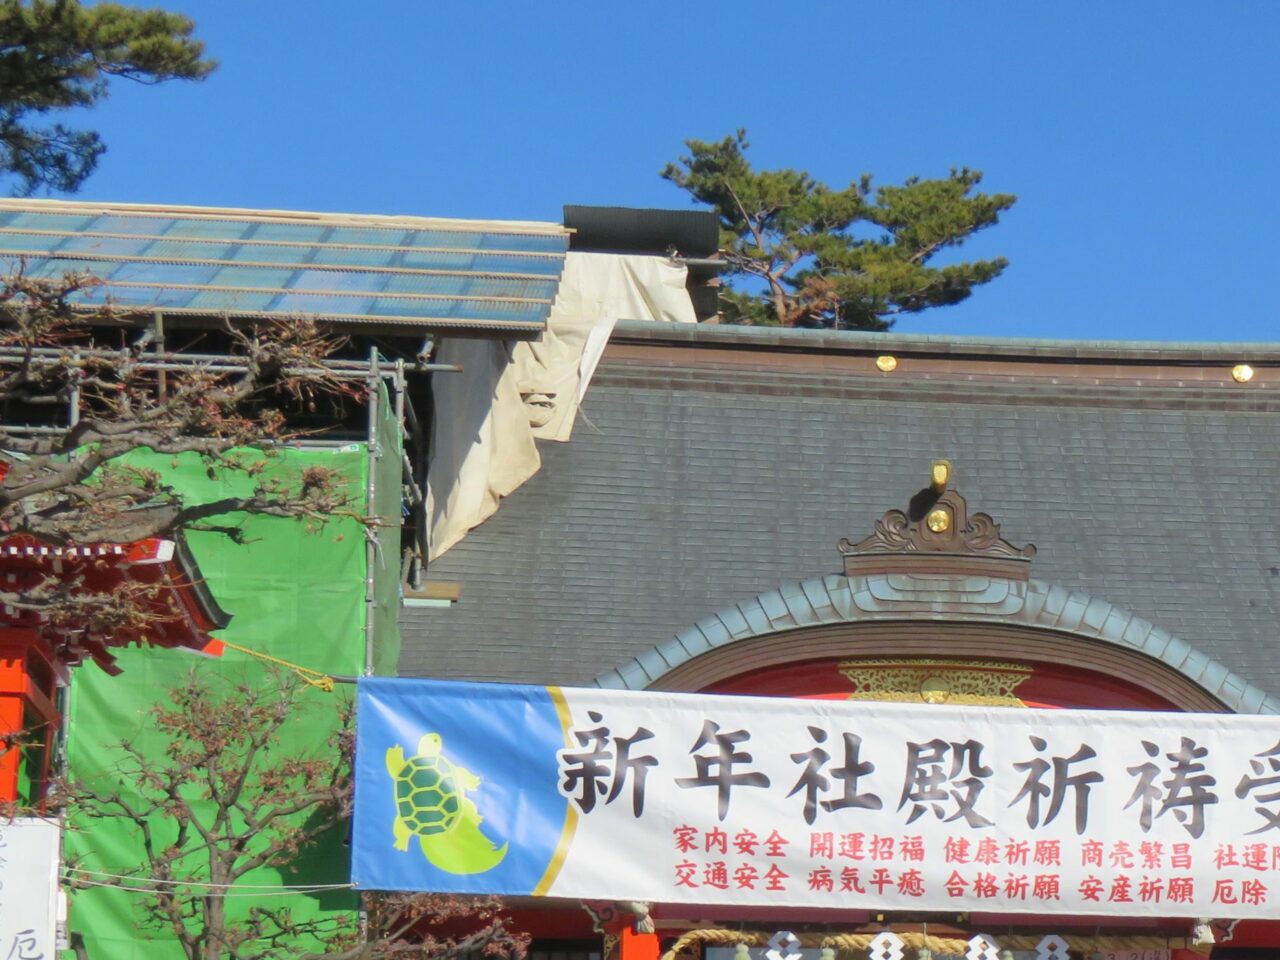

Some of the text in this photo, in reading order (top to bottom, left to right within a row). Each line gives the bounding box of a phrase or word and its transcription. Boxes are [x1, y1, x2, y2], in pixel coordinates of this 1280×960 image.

[672, 824, 790, 858] 家内安全
[808, 831, 926, 862] 開運招福
[943, 835, 1062, 867] 健康祈願
[1080, 840, 1194, 870] 商売繁昌
[673, 859, 790, 892] 交通安全
[808, 865, 926, 898] 病気平癒
[944, 868, 1062, 901] 合格祈願
[1078, 874, 1196, 904] 安産祈願
[1211, 877, 1268, 907] 厄除
